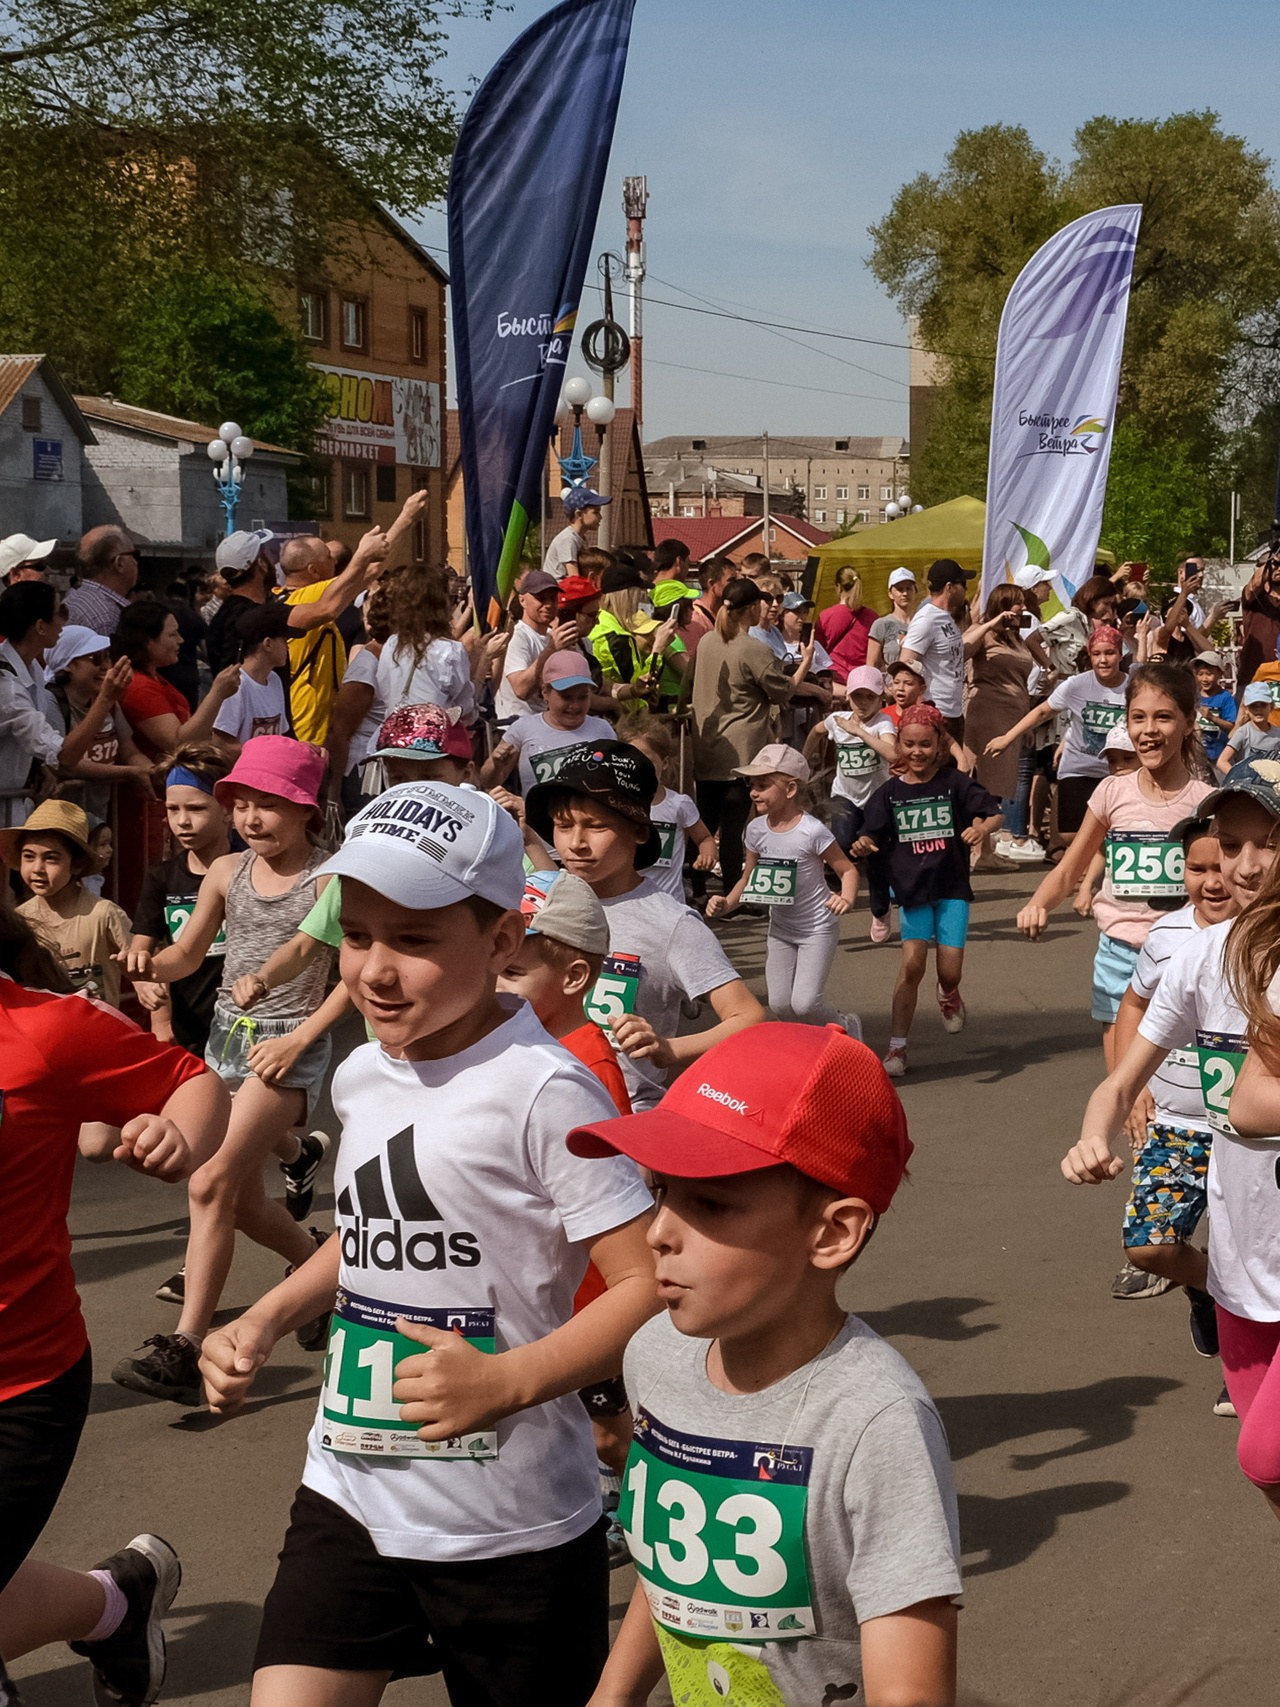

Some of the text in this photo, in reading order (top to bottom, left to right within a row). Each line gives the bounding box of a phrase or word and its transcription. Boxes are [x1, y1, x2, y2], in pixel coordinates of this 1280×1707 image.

[1018, 409, 1071, 435] Быстрее
[1039, 432, 1080, 457] Ветра
[838, 749, 878, 769] 252
[359, 799, 464, 843] HOLIDAYS
[369, 822, 420, 844] TIME
[896, 805, 951, 831] 1715
[1114, 846, 1186, 881] 256
[697, 1082, 749, 1116] Reebok
[337, 1215, 482, 1272] didas
[324, 1328, 402, 1421] 11
[622, 1458, 788, 1598] 133
